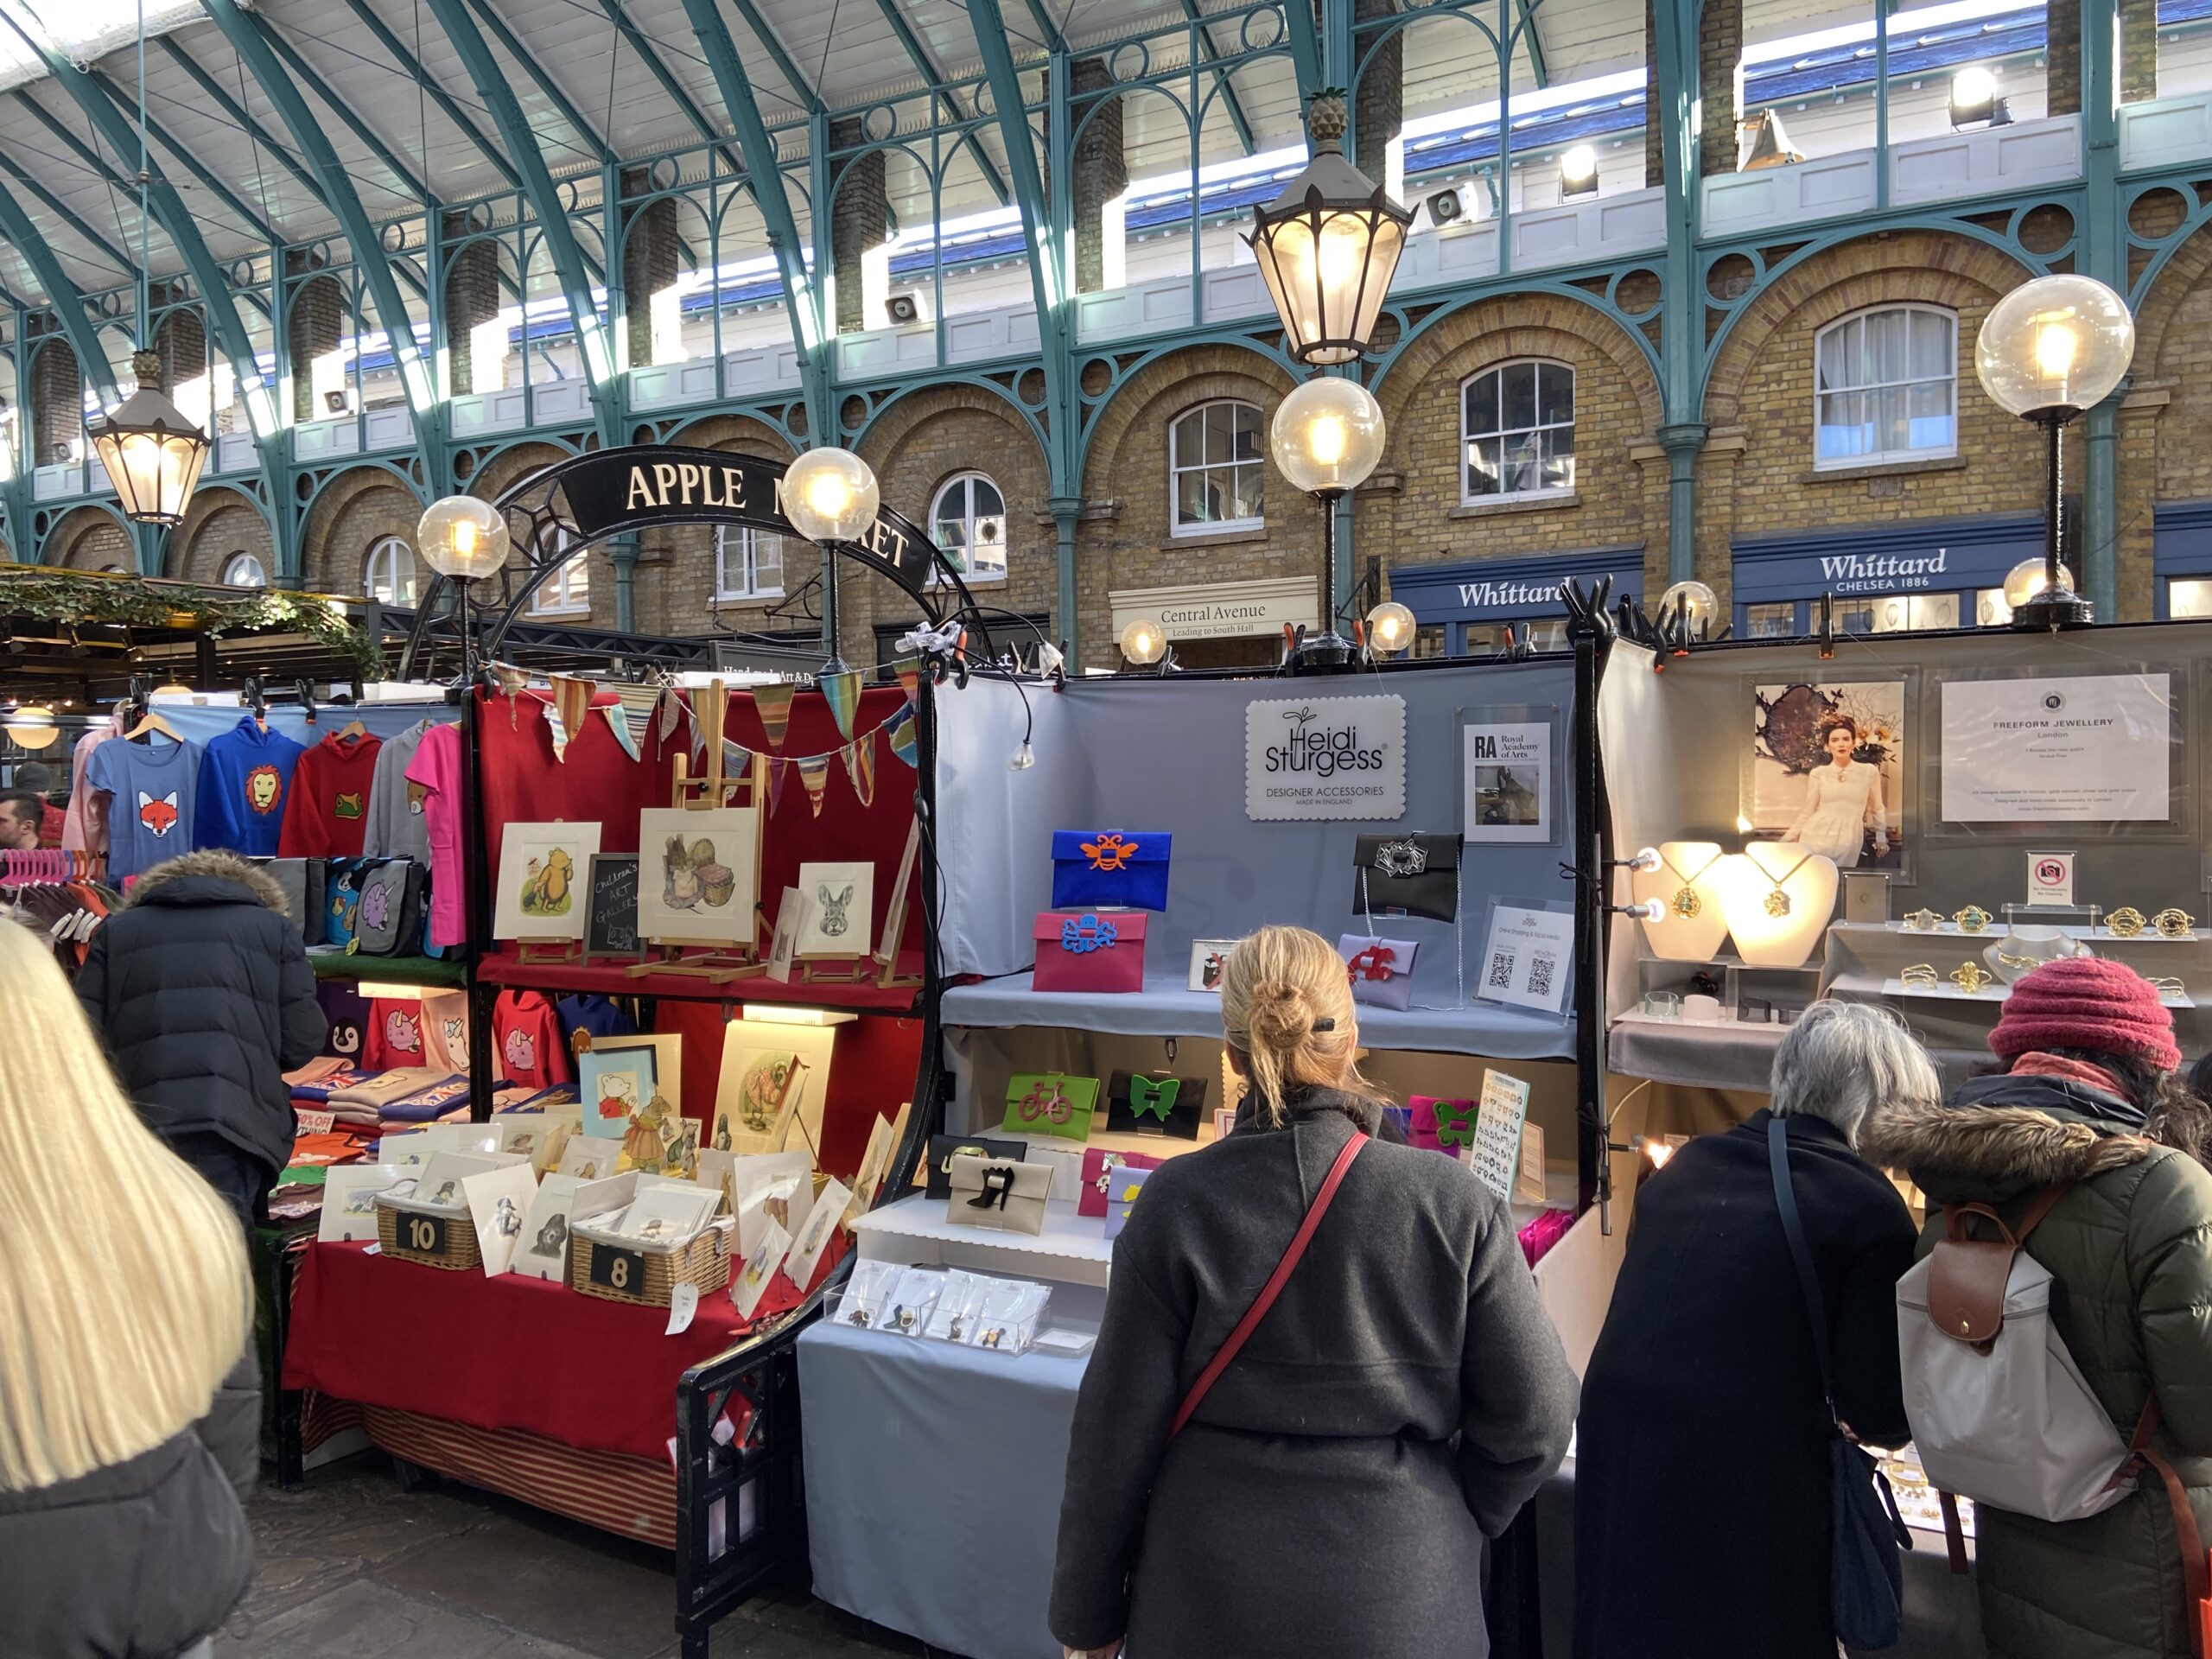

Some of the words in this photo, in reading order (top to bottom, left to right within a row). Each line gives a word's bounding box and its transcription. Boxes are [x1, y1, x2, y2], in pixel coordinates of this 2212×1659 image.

[626, 464, 747, 510] APPLE
[1820, 548, 1947, 580] Whittard
[1836, 580, 1895, 592] CHELSEA
[1901, 576, 1929, 588] 1886
[1161, 607, 1211, 623] Central
[1213, 606, 1266, 620] Avenue
[1173, 627, 1203, 637] Leading
[1212, 625, 1236, 634] South
[1237, 624, 1254, 632] Hall
[1993, 721, 2049, 729] FREEFORM
[2054, 718, 2114, 728] JEWELLERY
[1290, 726, 1356, 751] Heidi
[1474, 735, 1497, 759] RA
[1501, 734, 1523, 744] Royal
[1501, 743, 1539, 752] Academy
[1266, 747, 1382, 778] Sturgess
[1267, 788, 1313, 798] DESIGNER
[1316, 786, 1384, 797] ACCESSORIES
[609, 881, 632, 903] ART
[315, 1116, 333, 1128] OFF
[409, 1218, 435, 1250] 10
[610, 1256, 629, 1288] 8
